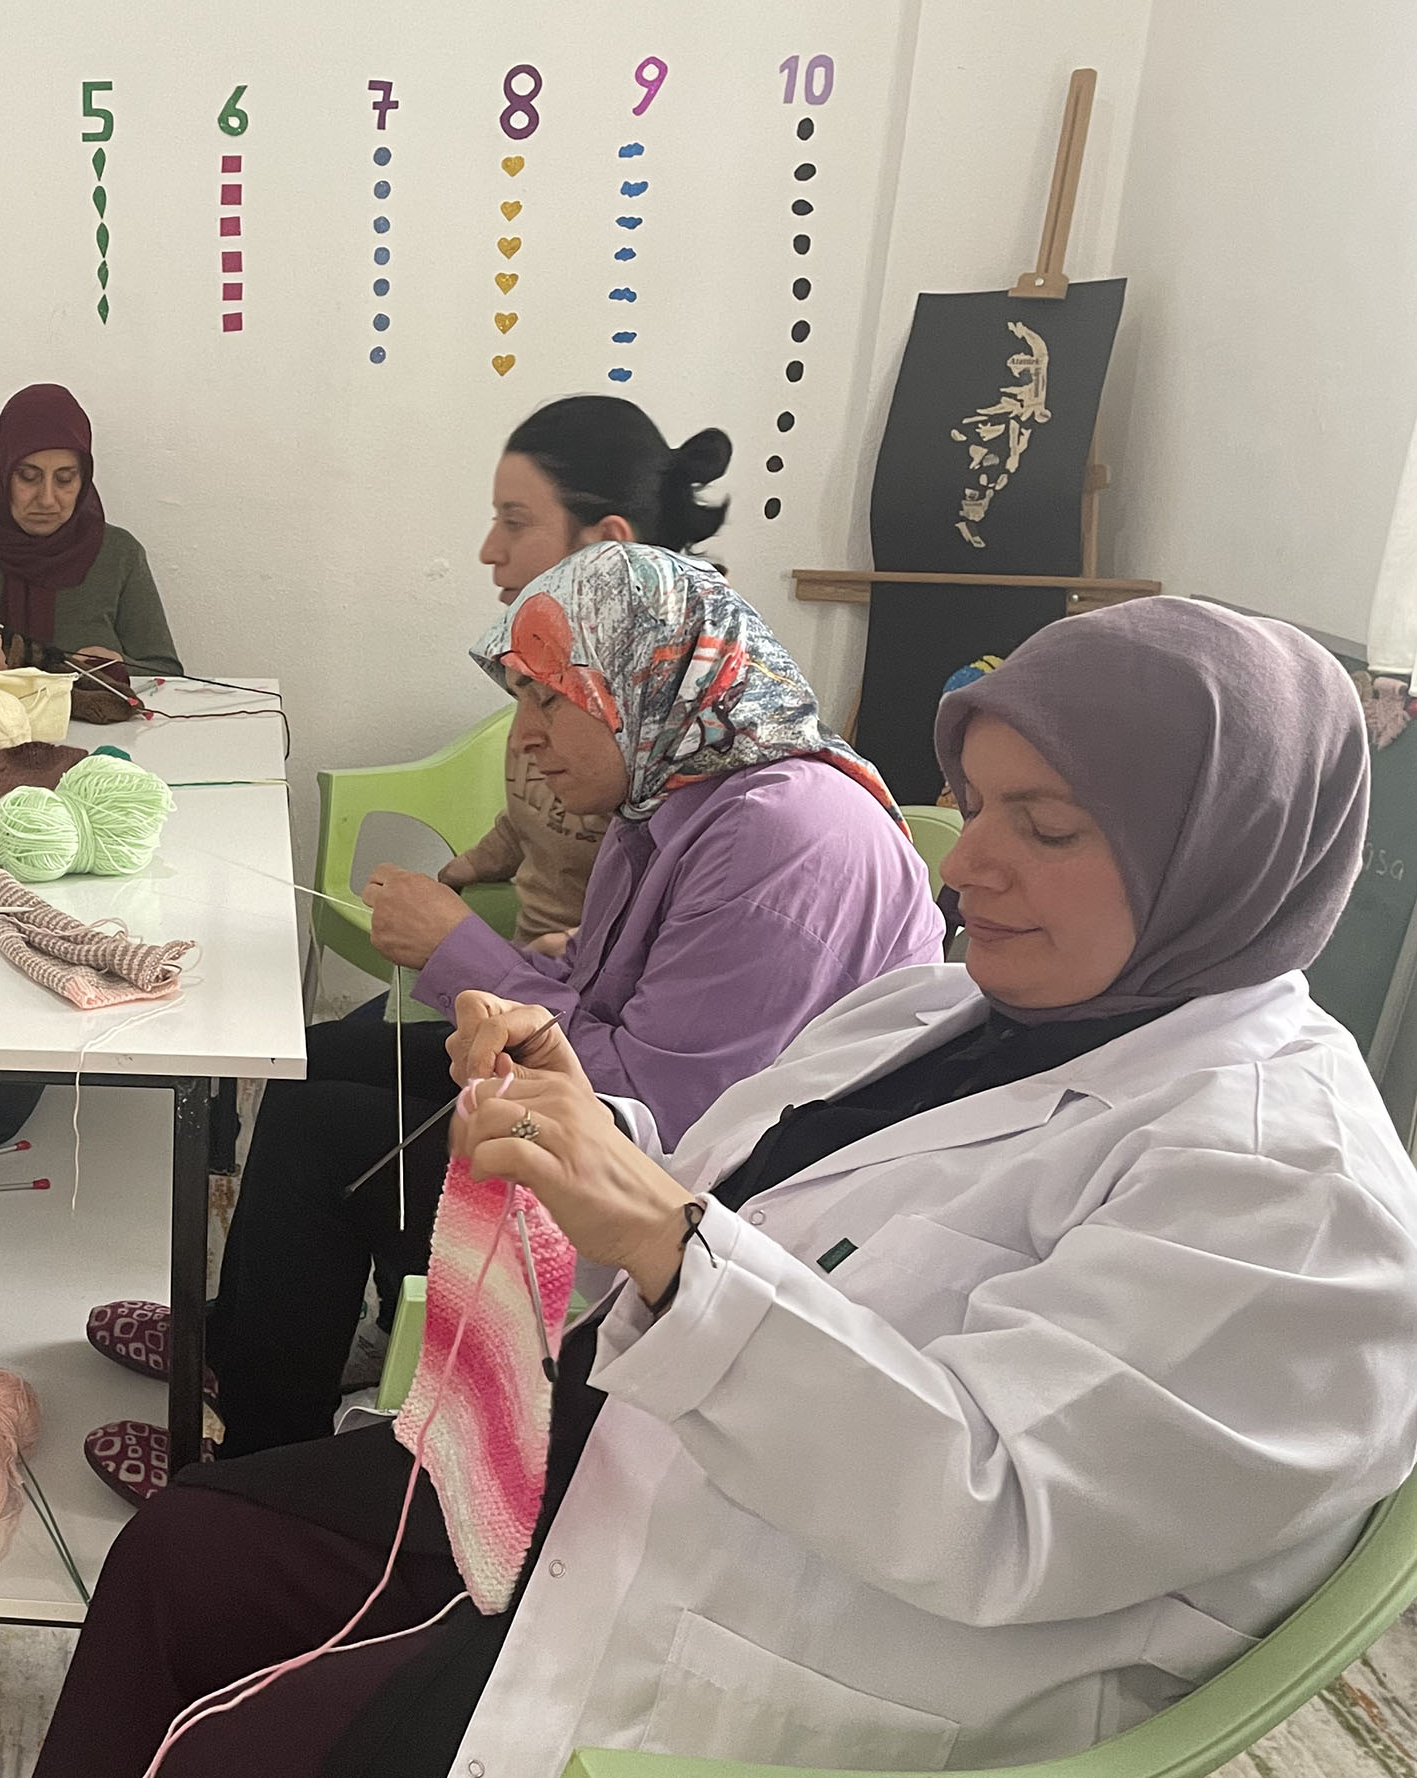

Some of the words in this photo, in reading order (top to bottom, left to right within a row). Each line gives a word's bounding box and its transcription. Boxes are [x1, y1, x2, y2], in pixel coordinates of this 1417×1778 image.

[81, 81, 114, 142] 5
[217, 85, 249, 137] 6
[367, 80, 399, 131] 7
[499, 64, 543, 141] 8
[631, 56, 669, 117] 9
[778, 54, 835, 107] 10
